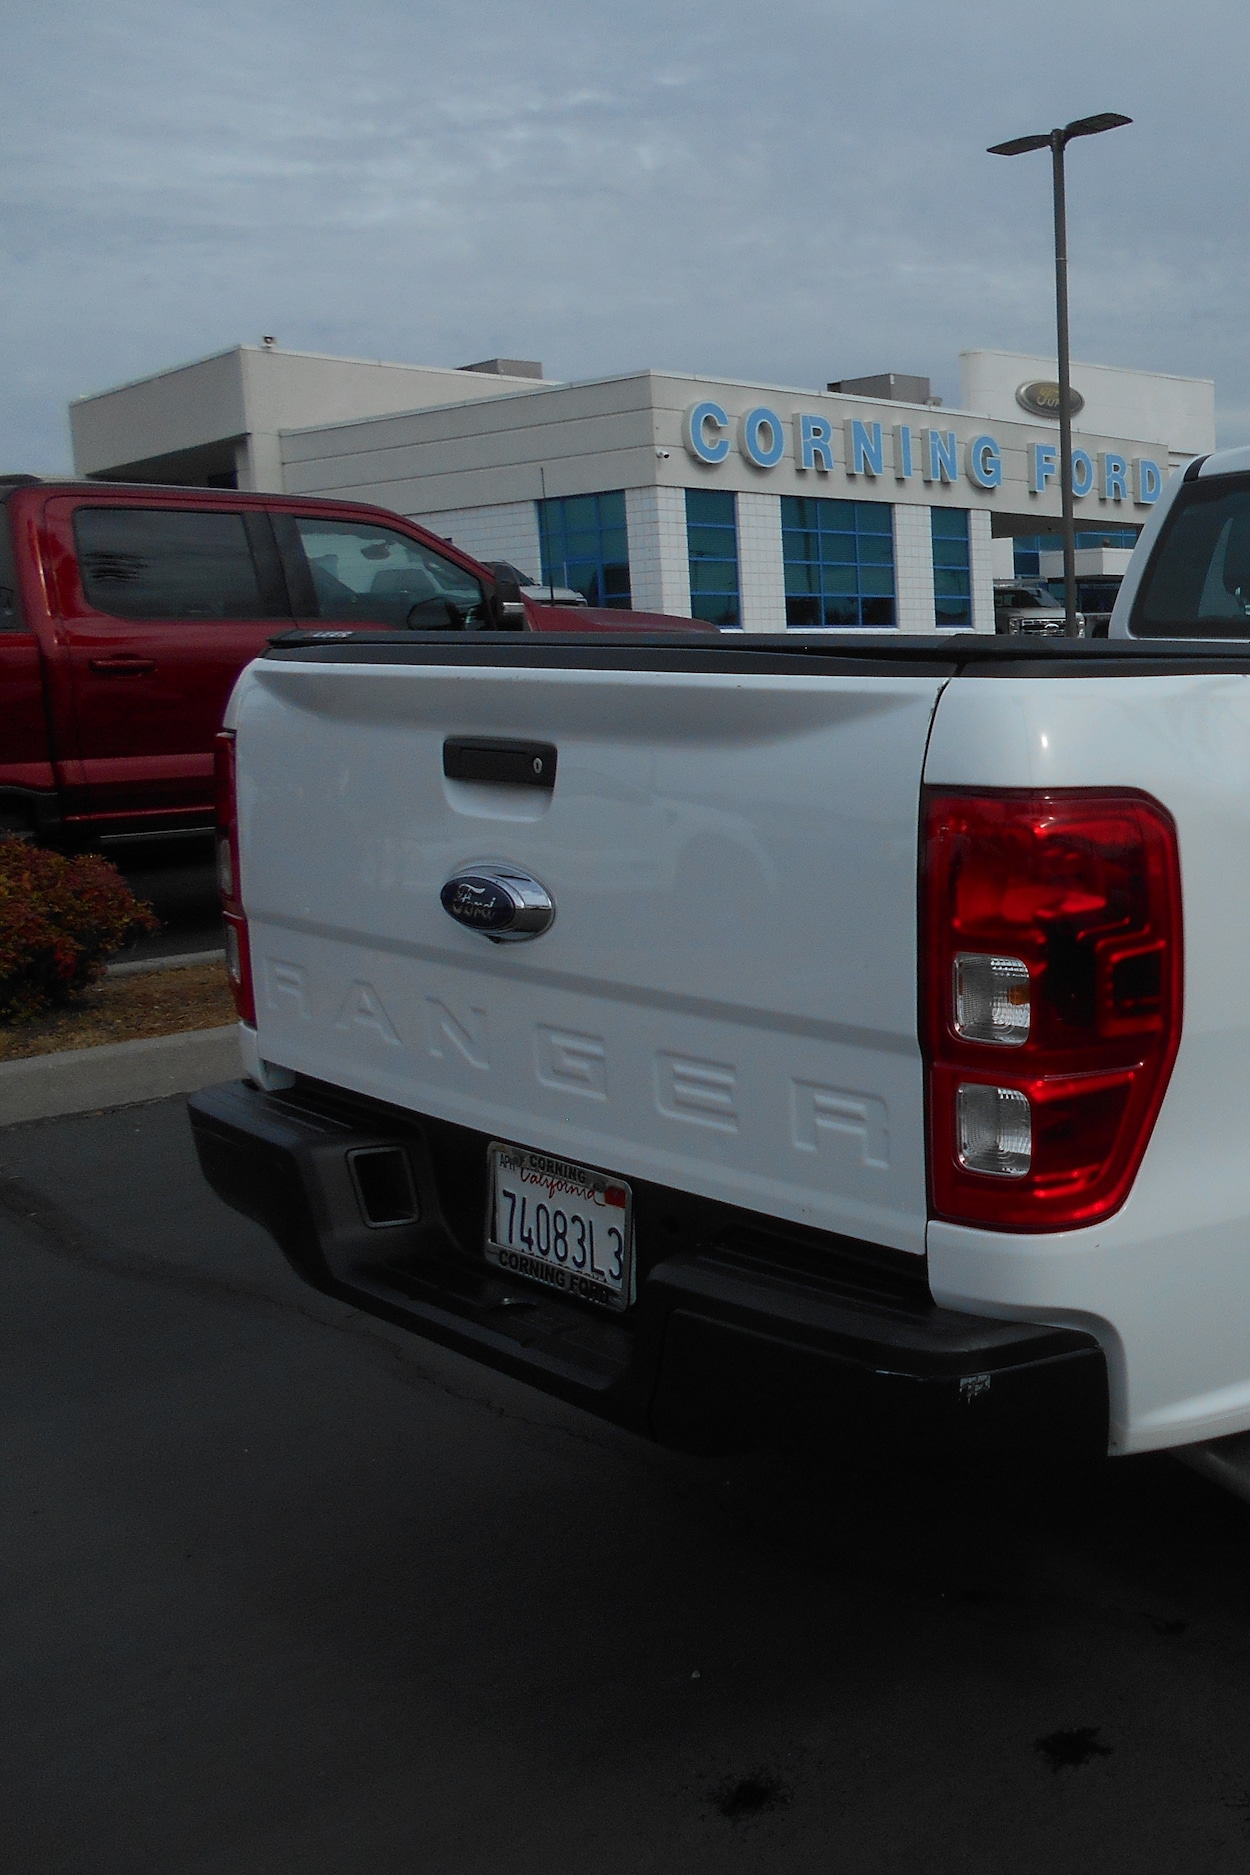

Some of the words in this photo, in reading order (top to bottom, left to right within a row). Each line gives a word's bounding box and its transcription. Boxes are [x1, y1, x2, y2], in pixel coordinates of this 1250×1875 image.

[684, 400, 1001, 488] CORNING
[1029, 443, 1163, 505] FORD
[453, 883, 496, 920] Ford
[265, 956, 889, 1169] RANGER
[520, 1167, 606, 1207] California
[529, 1155, 586, 1184] CORNING
[503, 1189, 623, 1281] 74083L3
[499, 1250, 565, 1287] CORNING
[570, 1273, 609, 1304] FORD
